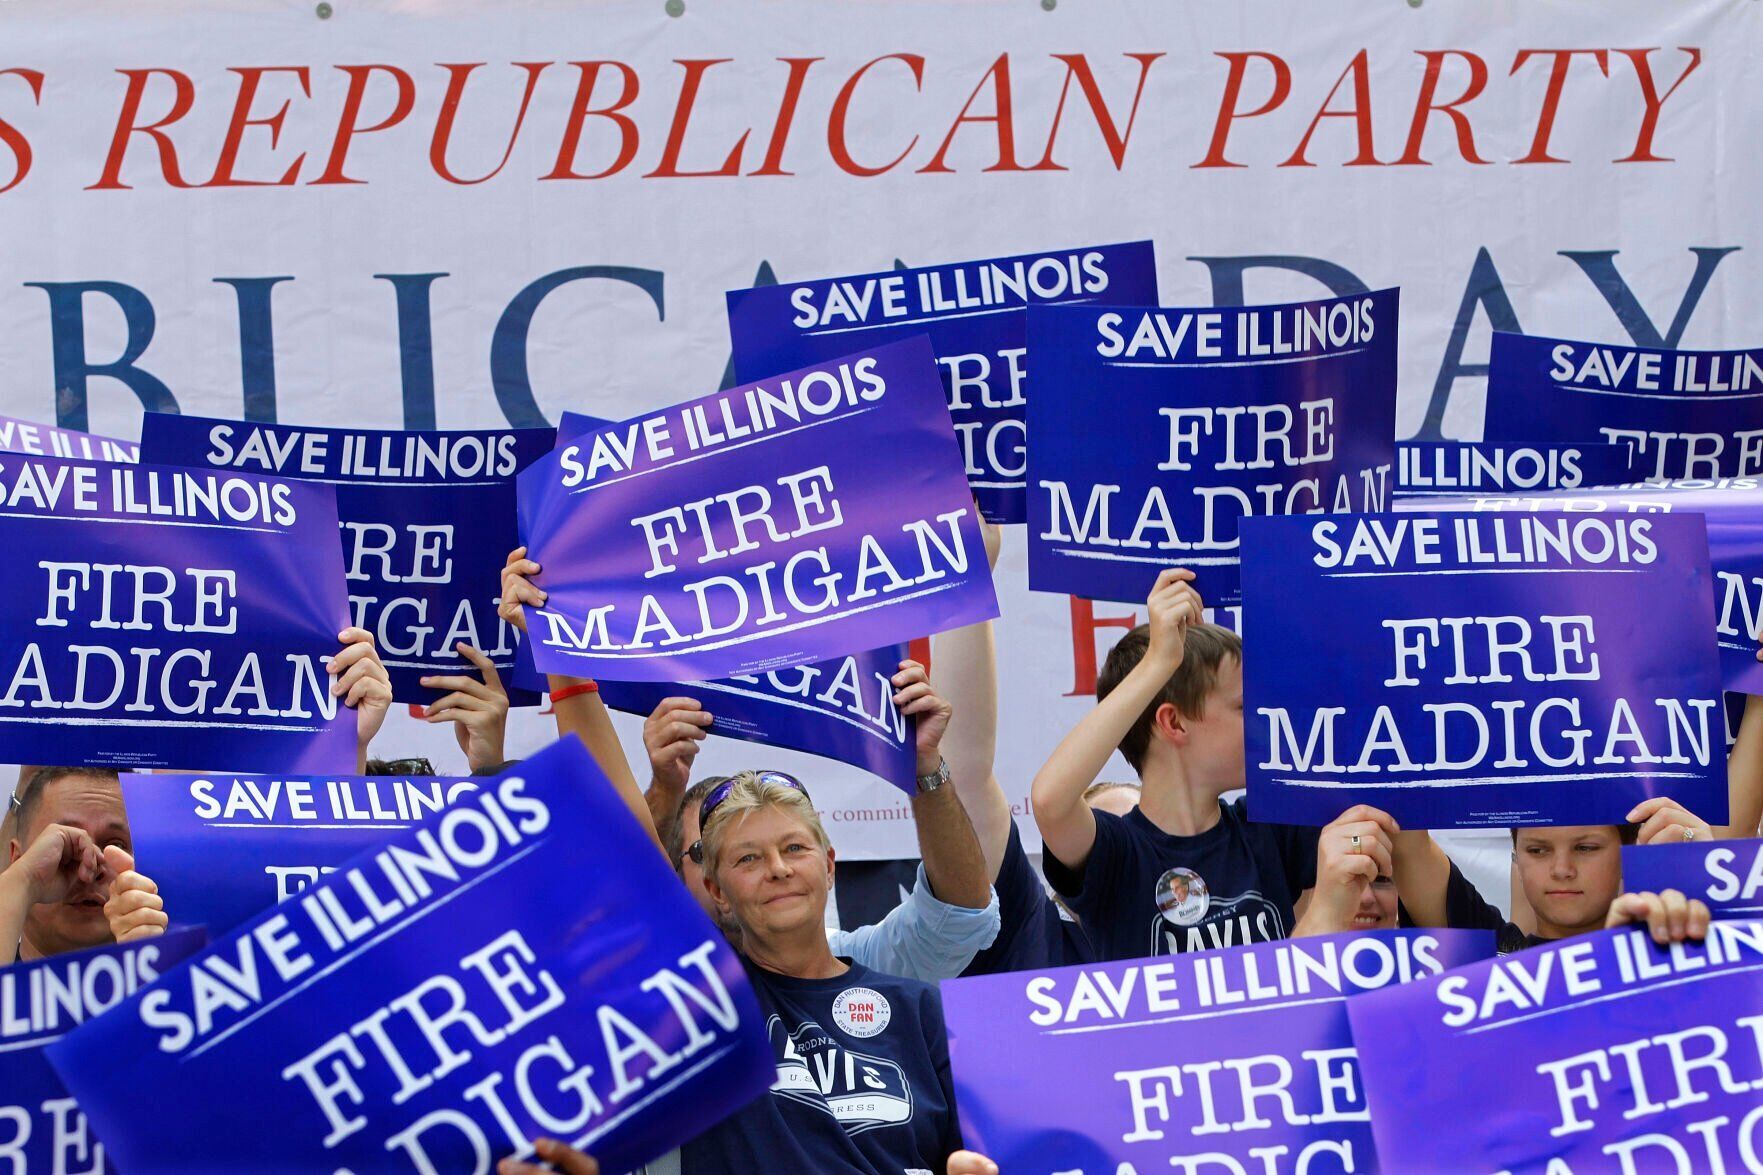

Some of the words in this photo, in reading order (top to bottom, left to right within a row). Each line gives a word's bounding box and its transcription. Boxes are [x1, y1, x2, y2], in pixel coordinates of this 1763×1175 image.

[83, 52, 1167, 190] REPUBLICAN
[1189, 47, 1704, 168] PARTY
[790, 276, 907, 328] SAVE
[918, 252, 1109, 313] ILLINOIS
[1097, 311, 1222, 360] SAVE
[1237, 298, 1375, 357] ILLINOIS
[1186, 245, 1743, 442] AY
[1550, 344, 1662, 389] SAVE
[206, 425, 328, 474] SAVE
[341, 434, 517, 480] ILLINOIS
[560, 415, 675, 487] SAVE
[682, 357, 886, 451] ILLINOIS
[1157, 398, 1334, 471] FIRE
[0, 460, 98, 512] AVE
[112, 469, 296, 527] ILLINOIS
[1399, 446, 1583, 489] ILLINOIS
[339, 521, 454, 583] RE
[631, 465, 844, 578] FIRE
[1311, 518, 1442, 568] SAVE
[1456, 515, 1658, 565] ILLINOIS
[36, 561, 238, 635] FIRE
[536, 508, 969, 651] MADIGAN
[1382, 615, 1600, 688] FIRE
[1257, 698, 1716, 774] MADIGAN
[190, 778, 318, 821] SAVE
[832, 800, 914, 821] commit
[139, 913, 316, 1053] SAVE
[301, 776, 551, 953] ILLINOIS
[848, 1003, 874, 1012] DAN
[850, 1013, 874, 1023] FAN
[1026, 960, 1180, 1026] SAVE
[1194, 936, 1444, 1008] ILLINOIS
[1436, 942, 1602, 1028] SAVE
[282, 928, 566, 1149] FIRE
[329, 940, 740, 1175] DIGAN
[1114, 1047, 1372, 1143] FIRE
